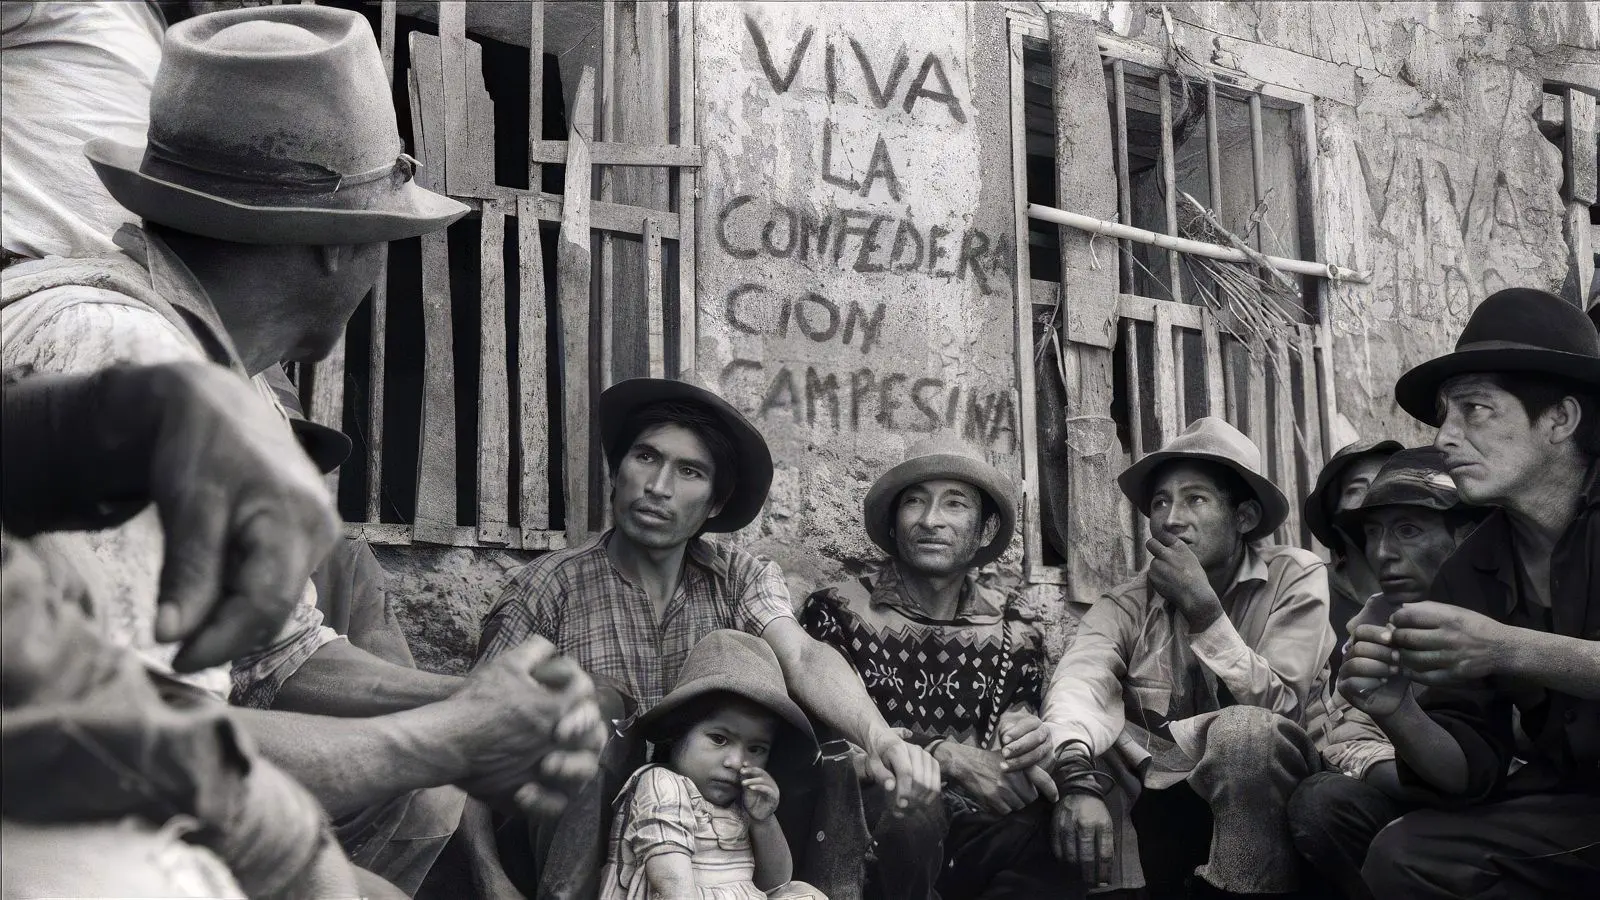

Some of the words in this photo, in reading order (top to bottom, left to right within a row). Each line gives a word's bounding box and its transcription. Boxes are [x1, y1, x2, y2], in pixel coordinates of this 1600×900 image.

[744, 12, 968, 124] VIVA
[821, 117, 902, 203] LA
[726, 283, 887, 354] CION
